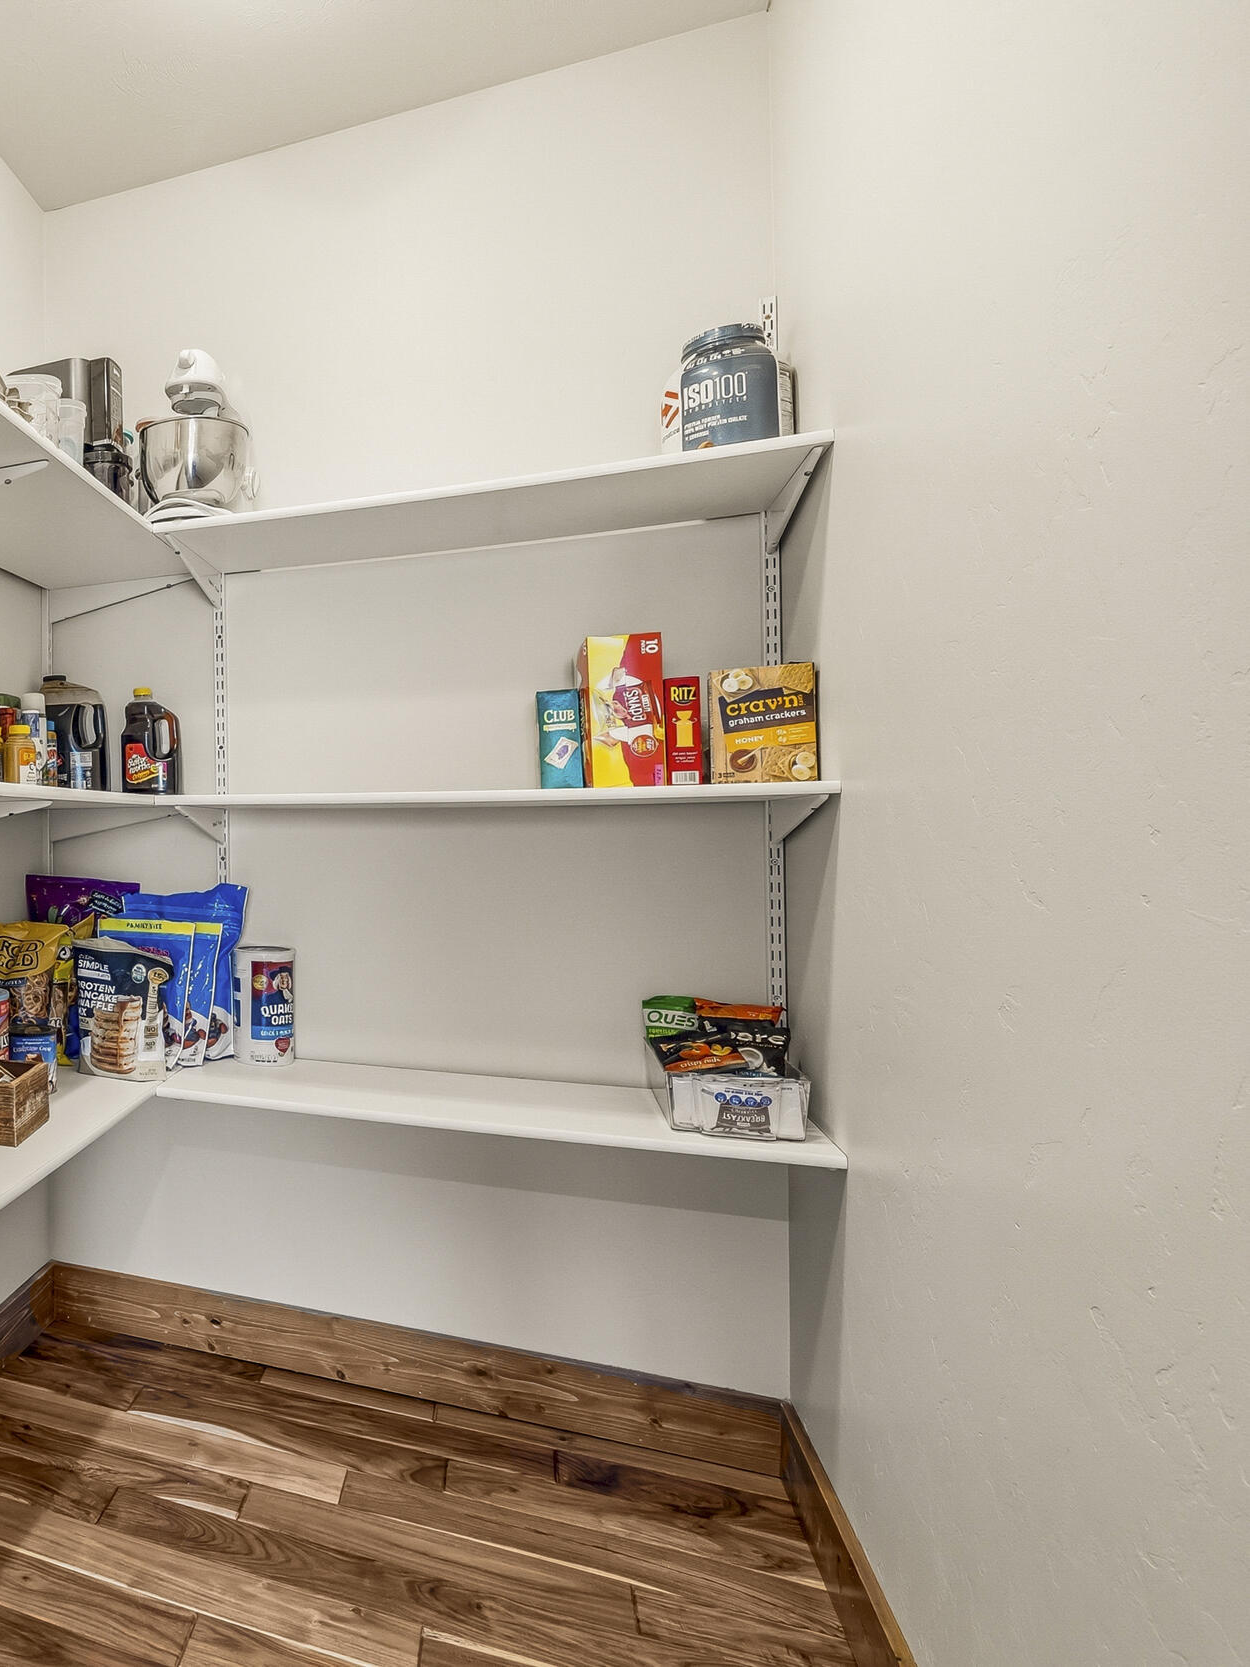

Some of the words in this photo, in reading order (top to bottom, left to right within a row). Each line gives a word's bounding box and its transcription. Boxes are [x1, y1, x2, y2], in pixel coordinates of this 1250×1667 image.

[645, 638, 659, 654] 10
[670, 686, 697, 702] RITZ
[544, 709, 576, 724] CLUB
[728, 714, 764, 727] graham
[765, 708, 807, 721] crackers
[735, 734, 765, 745] HONEY
[77, 959, 110, 973] SIMPLE
[77, 990, 118, 1003] ANCAKE
[260, 1003, 294, 1018] QUAKE
[271, 1015, 293, 1026] OATS
[647, 1010, 696, 1029] QUES
